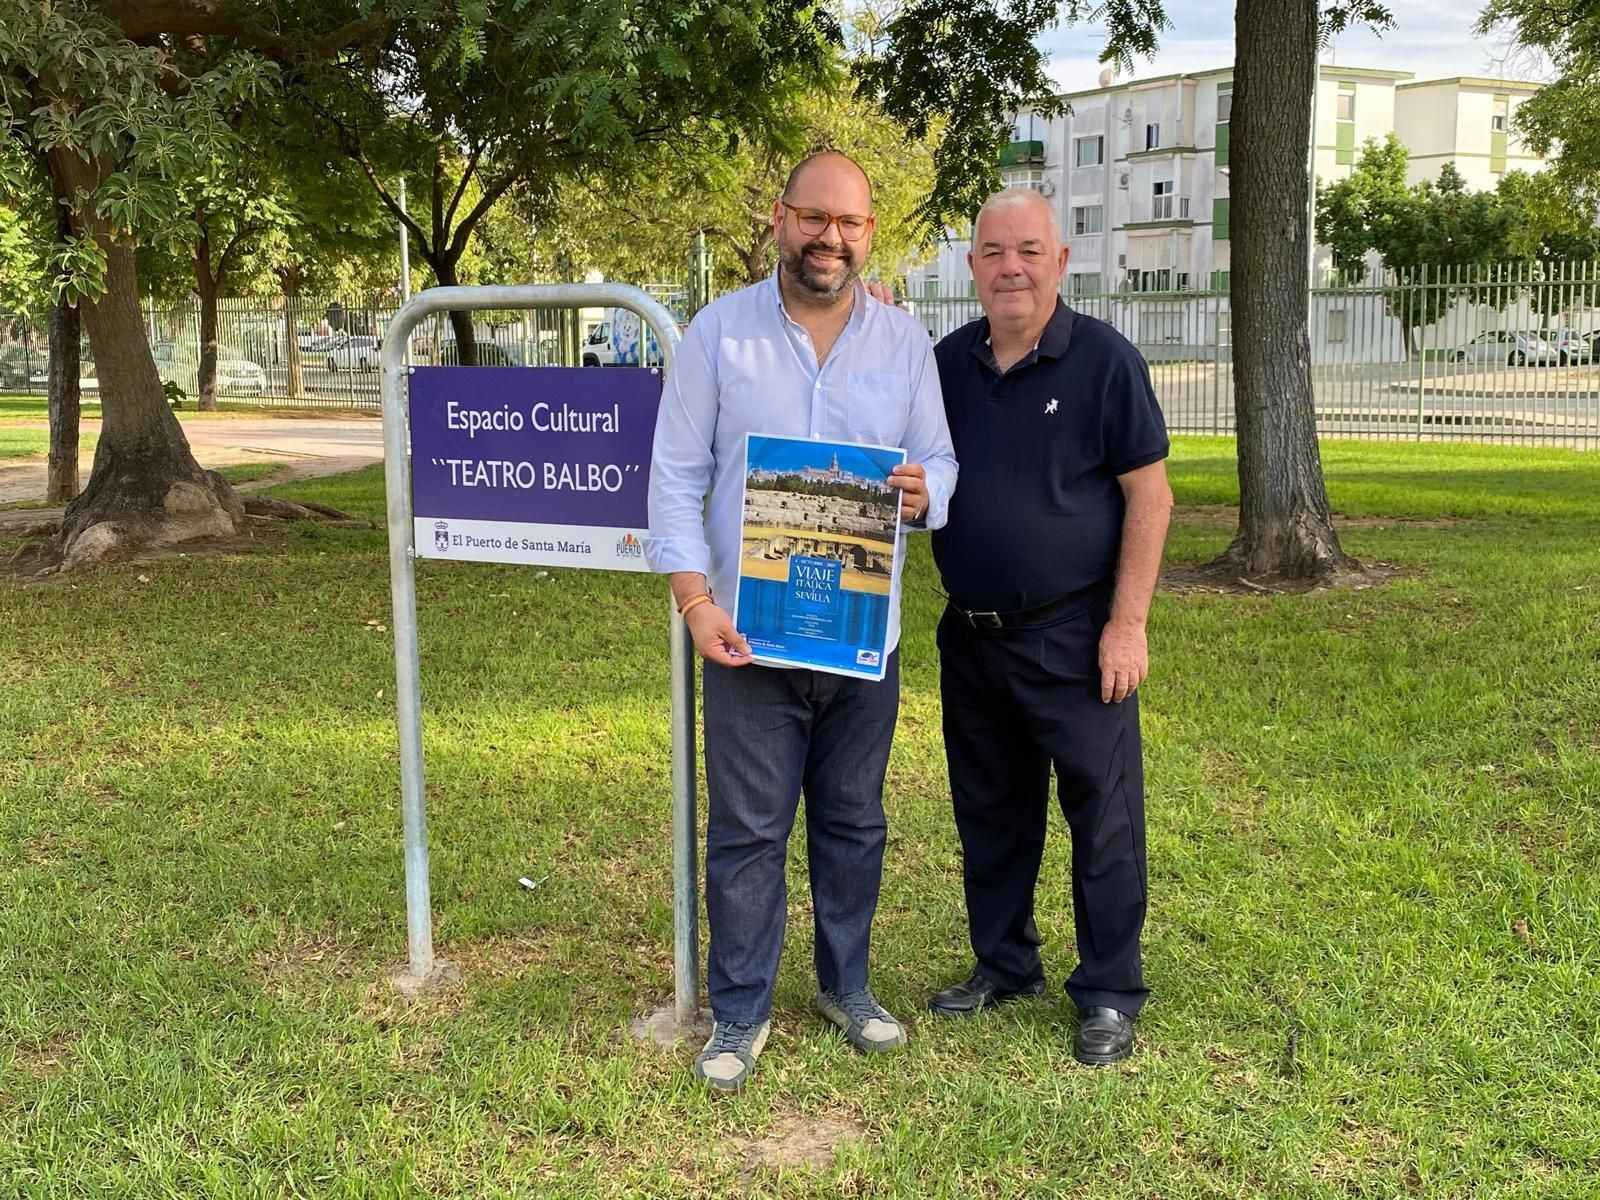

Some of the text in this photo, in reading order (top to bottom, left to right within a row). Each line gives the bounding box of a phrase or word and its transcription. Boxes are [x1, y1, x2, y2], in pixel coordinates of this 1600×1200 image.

[446, 401, 620, 438] Espacio Cultural
[452, 535, 592, 554] El Puerto de Santa María
[616, 543, 642, 555] PUERTO
[796, 565, 835, 583] VIAJE
[795, 591, 830, 603] SEVILLA
